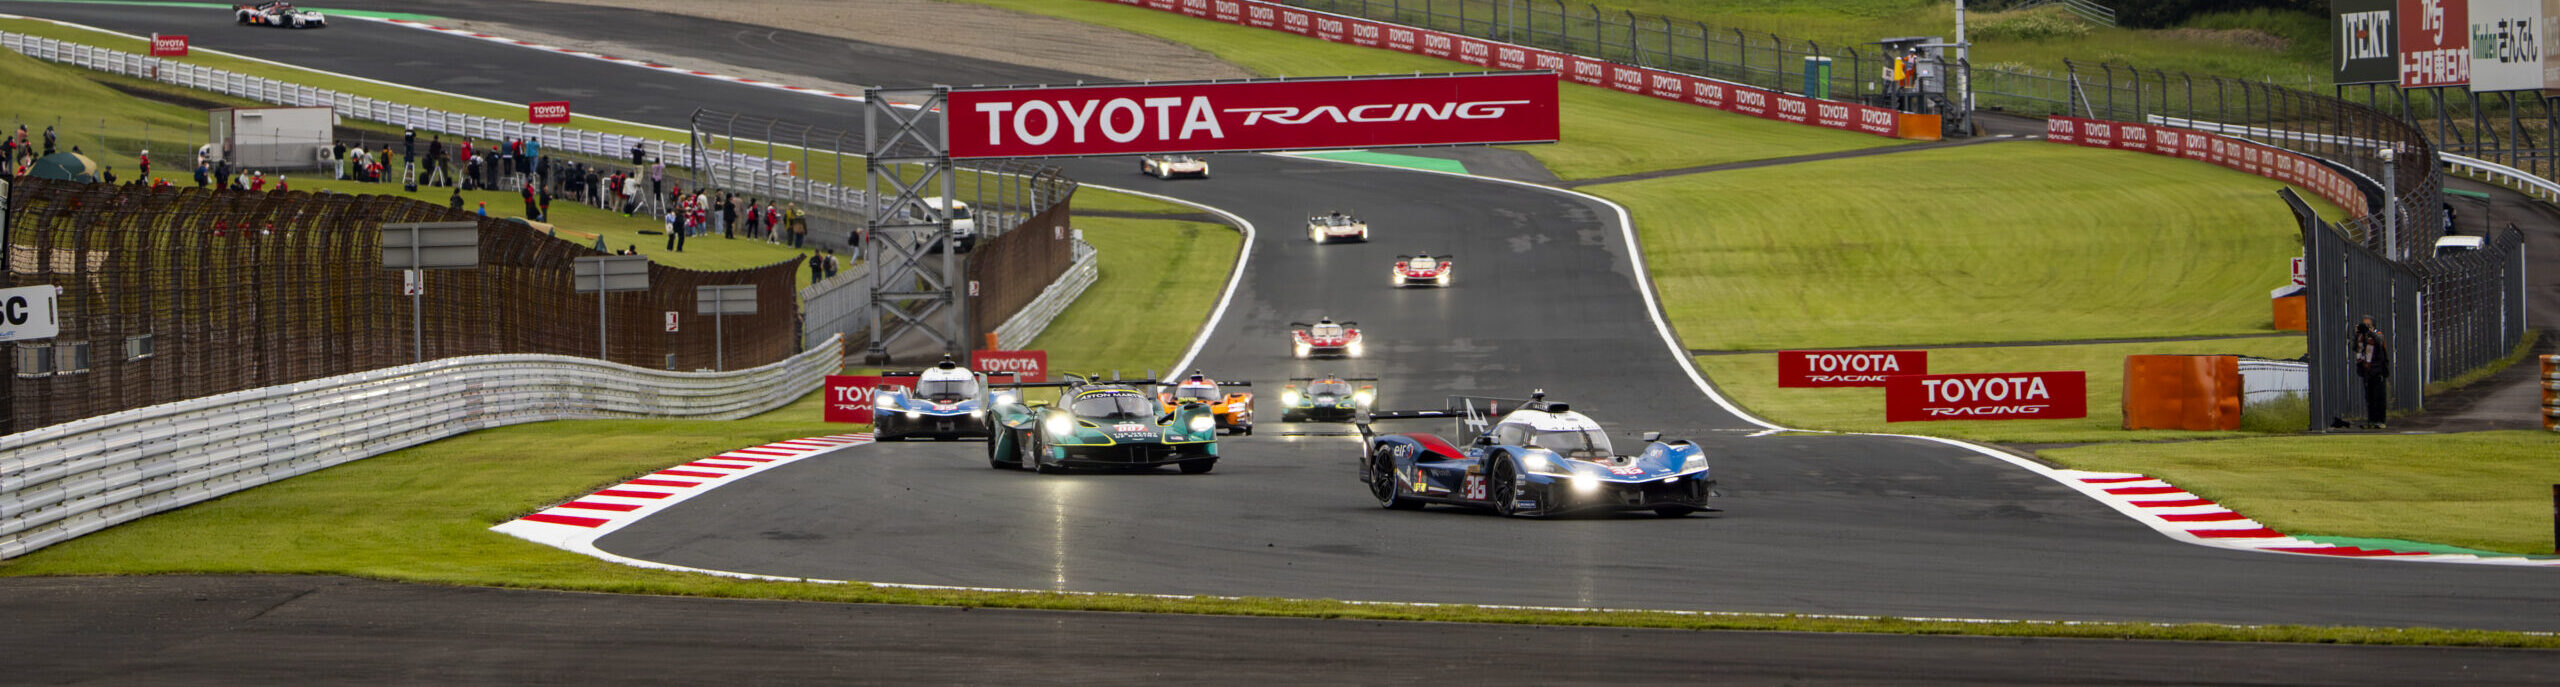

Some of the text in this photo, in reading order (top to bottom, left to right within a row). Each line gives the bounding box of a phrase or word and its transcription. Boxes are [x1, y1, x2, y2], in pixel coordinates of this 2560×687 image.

[1216, 0, 1240, 16] TOYOTA
[1249, 6, 1274, 20] TOYOTA
[1283, 11, 1308, 27] TOYOTA
[1317, 18, 1343, 33] TOYOTA
[1353, 23, 1379, 39] TOYOTA
[1389, 28, 1414, 44] TOYOTA
[1425, 34, 1451, 50] TOYOTA
[2341, 10, 2390, 72] JTEKT
[2498, 17, 2538, 63] きんでん
[1461, 40, 1488, 57] TOYOTA
[1499, 47, 1525, 64] TOYOTA
[1536, 54, 1564, 70] TOYOTA
[1575, 61, 1602, 77] TOYOTA
[2401, 47, 2469, 85] トヨタ東日本
[1614, 68, 1642, 85] TOYOTA
[1652, 75, 1682, 92] TOYOTA
[1694, 82, 1723, 99] TOYOTA
[1736, 90, 1766, 107] TOYOTA
[533, 106, 566, 114] TOYOTA
[1777, 98, 1806, 115] TOYOTA
[1818, 104, 1849, 119] TOYOTA
[976, 96, 1530, 145] TOYOTA RACING
[1861, 108, 1892, 126] TOYOTA
[2048, 119, 2074, 133] TOYOTA
[2084, 122, 2111, 138] TOYOTA
[2122, 126, 2147, 141] TOYOTA
[2156, 130, 2178, 145] TOYOTA
[0, 295, 28, 325] C
[980, 357, 1039, 371] TOYOTA
[1805, 354, 1900, 372] TOYOTA
[1922, 377, 2050, 403] TOYOTA
[1923, 404, 2050, 416] RACING
[1394, 444, 1407, 457] elf
[1467, 475, 1486, 499] 36
